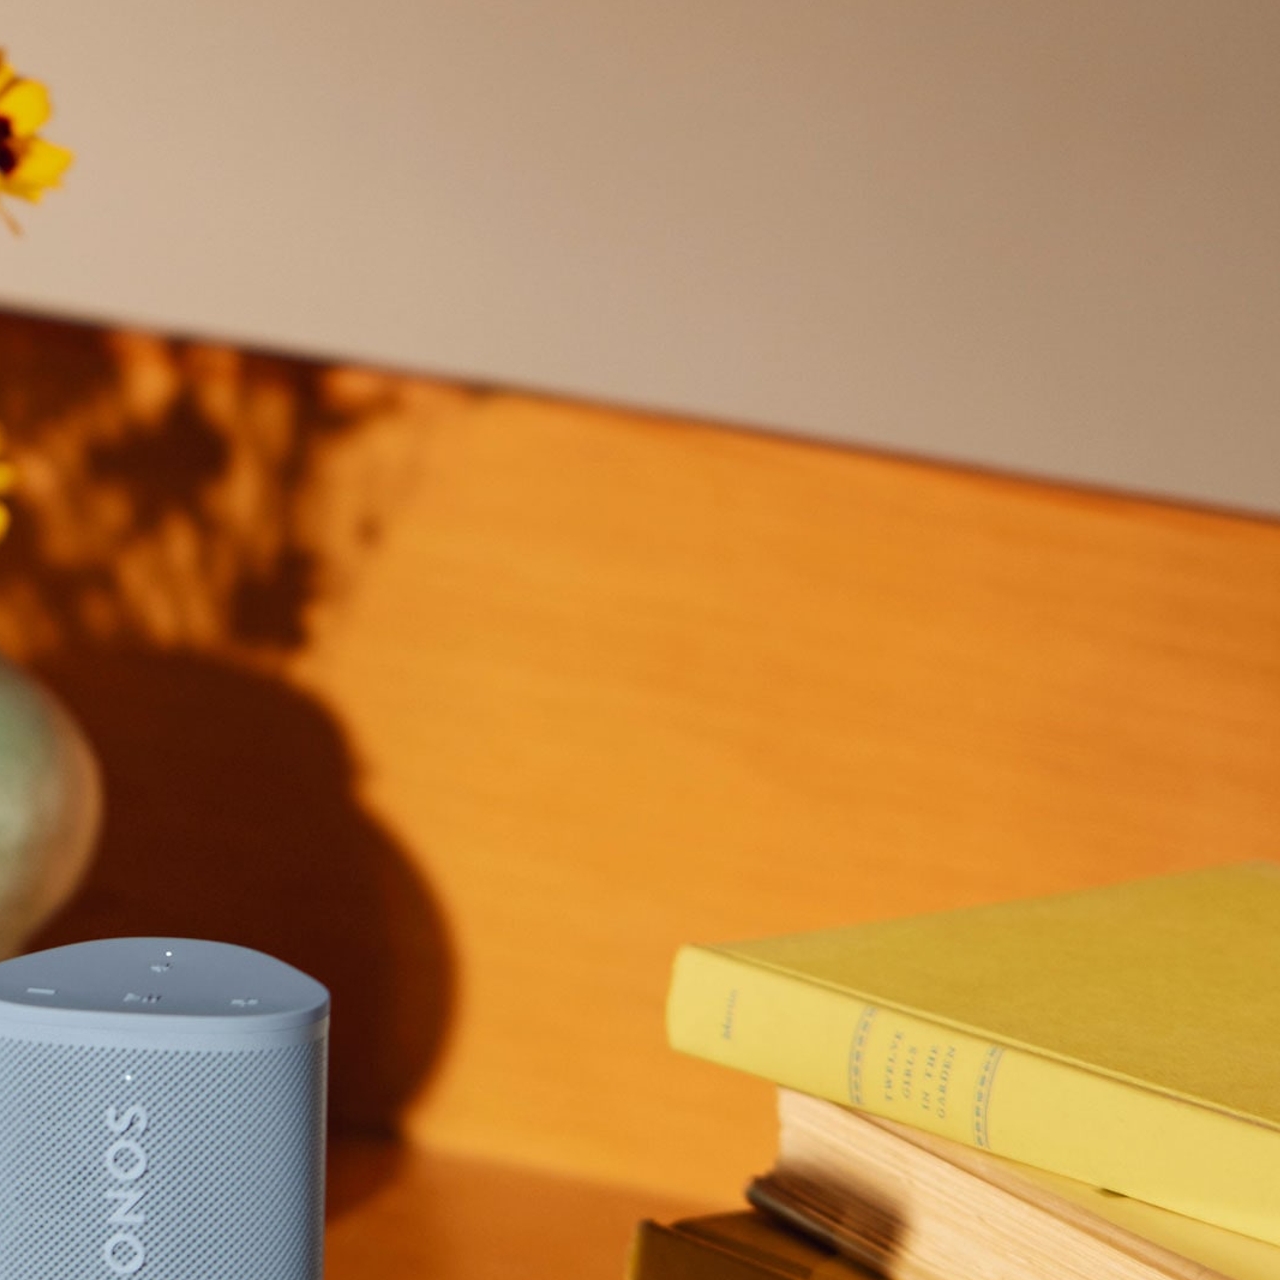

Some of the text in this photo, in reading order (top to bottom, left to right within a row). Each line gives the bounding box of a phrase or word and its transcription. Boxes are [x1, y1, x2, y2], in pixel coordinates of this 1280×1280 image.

[883, 1029, 905, 1102] TWELVE
[901, 1045, 919, 1099] GIRLS
[920, 1045, 940, 1111] IN THE
[936, 1045, 957, 1120] GARDEN
